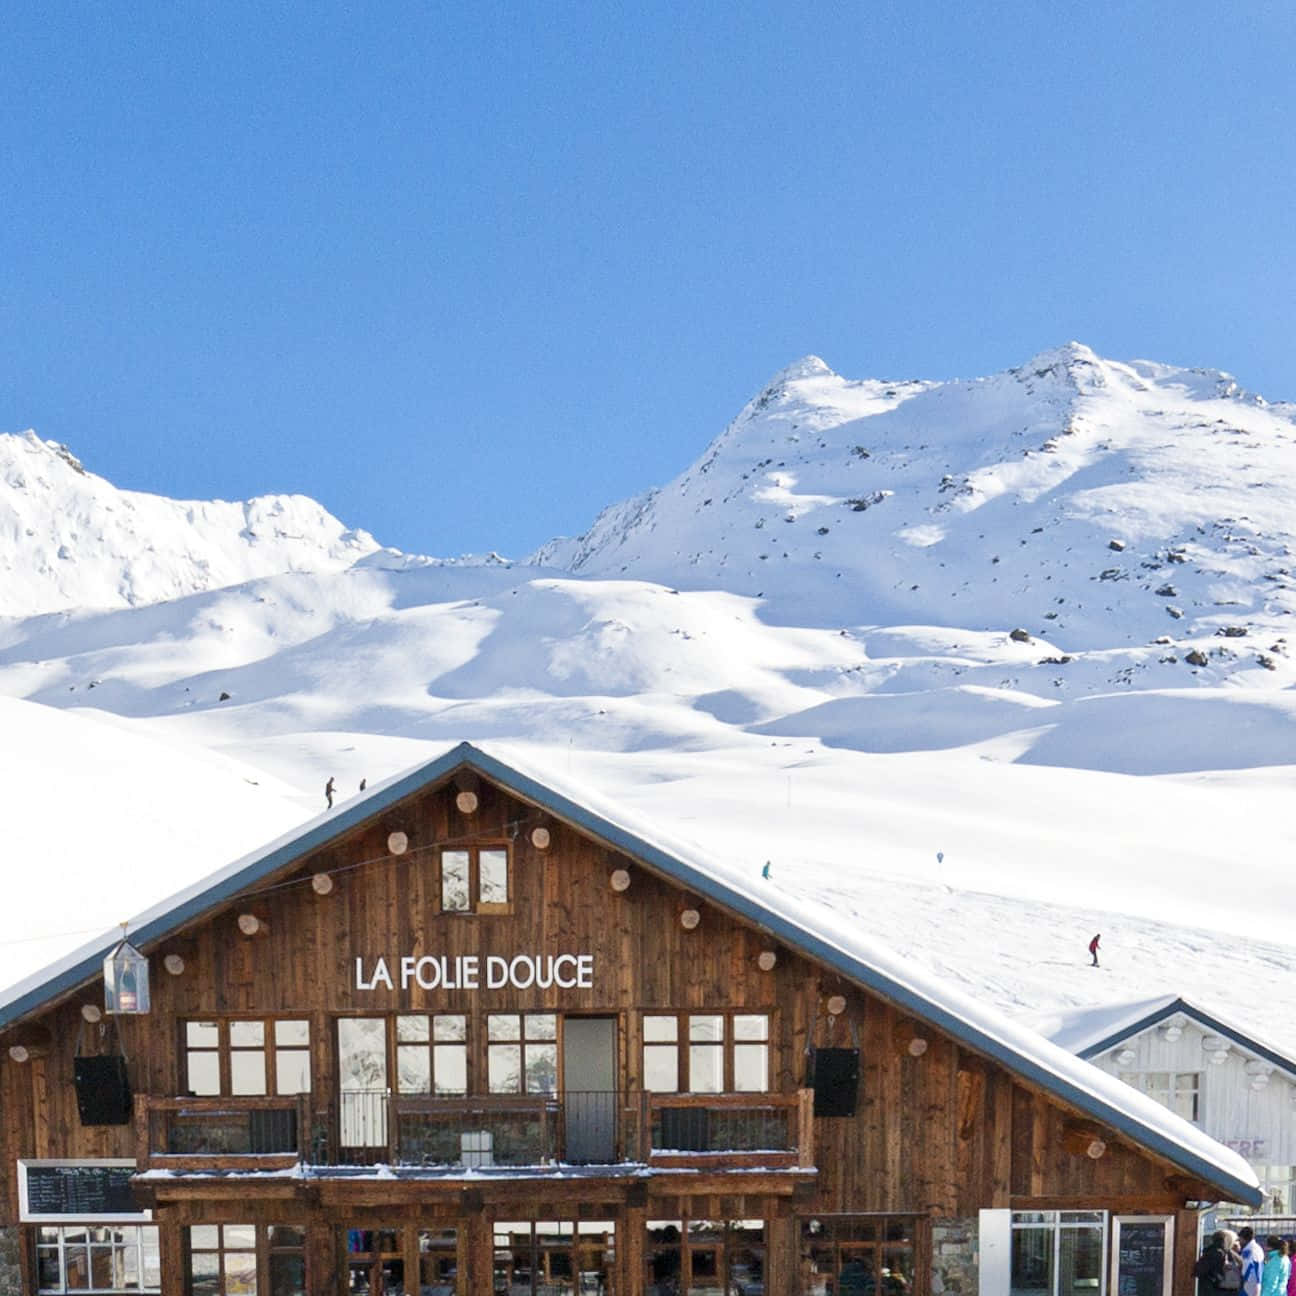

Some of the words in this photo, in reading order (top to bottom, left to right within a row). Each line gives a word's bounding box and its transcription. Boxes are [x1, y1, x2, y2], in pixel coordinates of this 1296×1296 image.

[356, 956, 393, 990] LA
[401, 956, 479, 990] FOLIE
[487, 954, 593, 990] DOUCE
